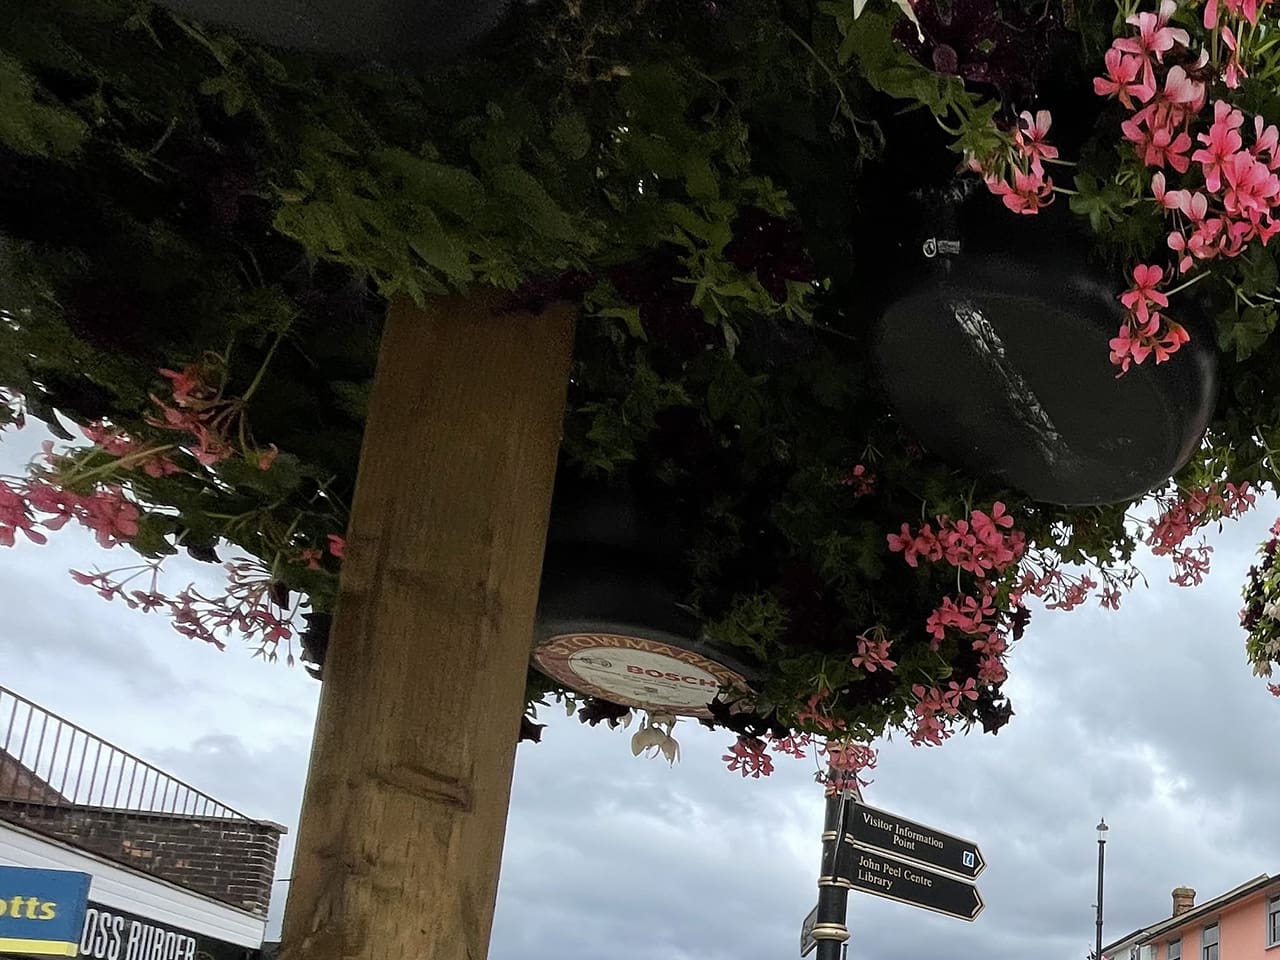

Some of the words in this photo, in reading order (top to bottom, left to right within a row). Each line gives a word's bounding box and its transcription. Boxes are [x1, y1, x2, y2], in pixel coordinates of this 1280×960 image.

[547, 636, 743, 684] STOWMARKE
[626, 664, 716, 688] BOSCH
[862, 812, 892, 832] Visitor
[895, 824, 943, 849] Information
[893, 835, 915, 850] Point
[858, 856, 880, 871] John
[883, 863, 901, 878] Peel
[904, 870, 933, 887] Centre
[858, 869, 893, 890] Library
